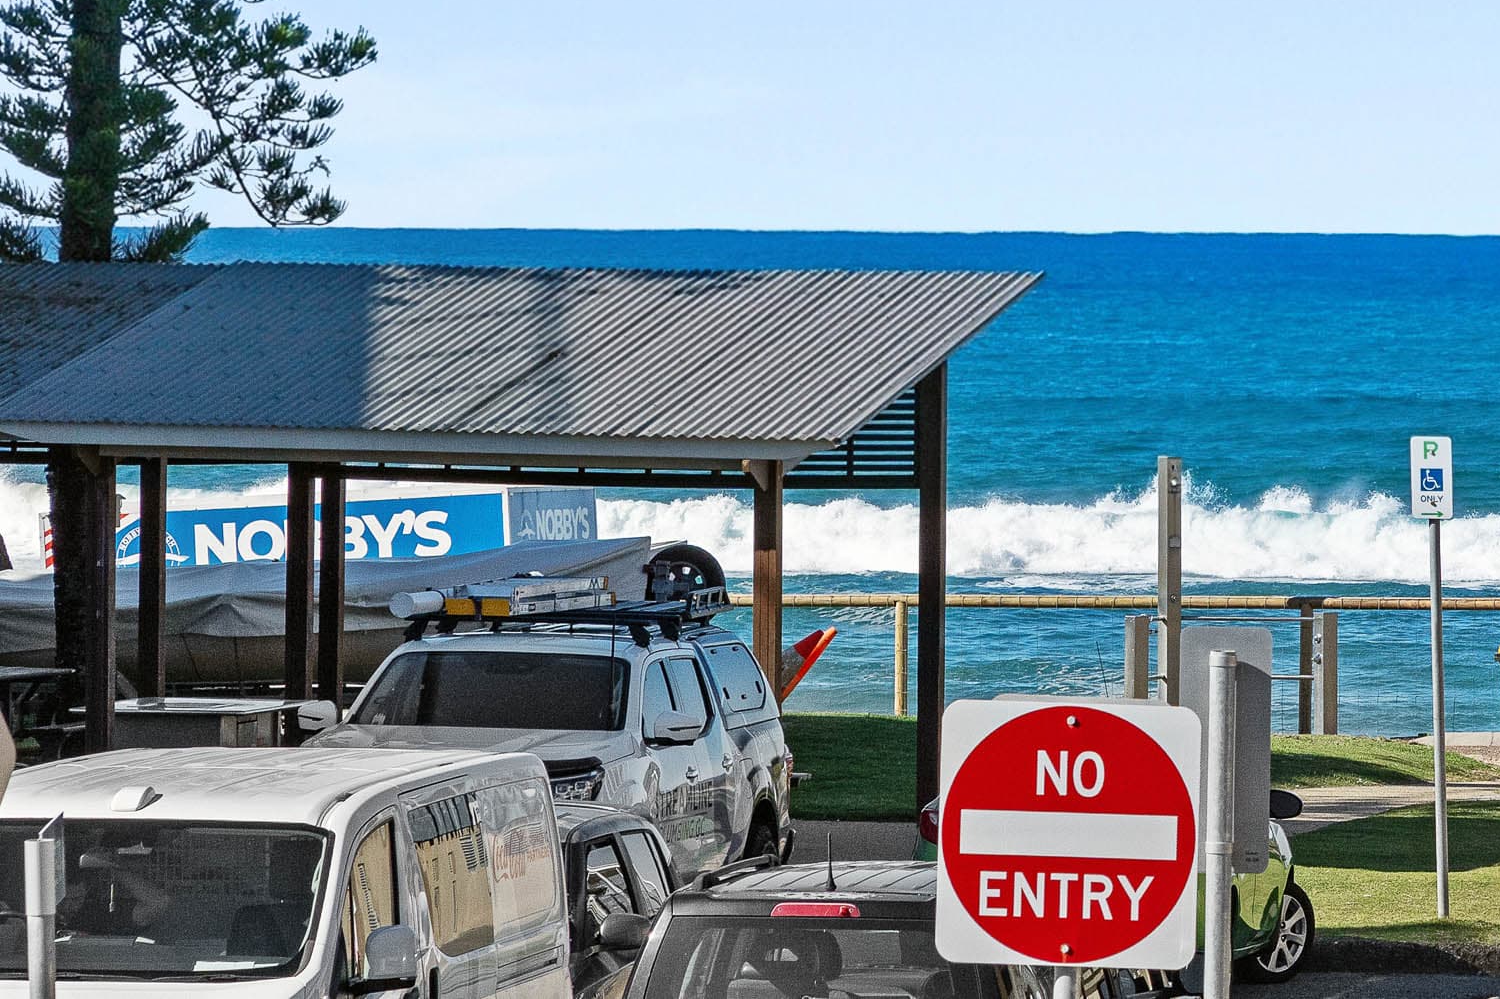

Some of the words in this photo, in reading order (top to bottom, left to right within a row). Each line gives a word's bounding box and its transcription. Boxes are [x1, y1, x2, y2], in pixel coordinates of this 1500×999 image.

[536, 506, 590, 541] NOBBY'S
[1421, 495, 1443, 503] ONLY
[194, 509, 452, 566] NOBY'S
[1035, 749, 1106, 798] NO
[978, 870, 1155, 922] ENTRY
